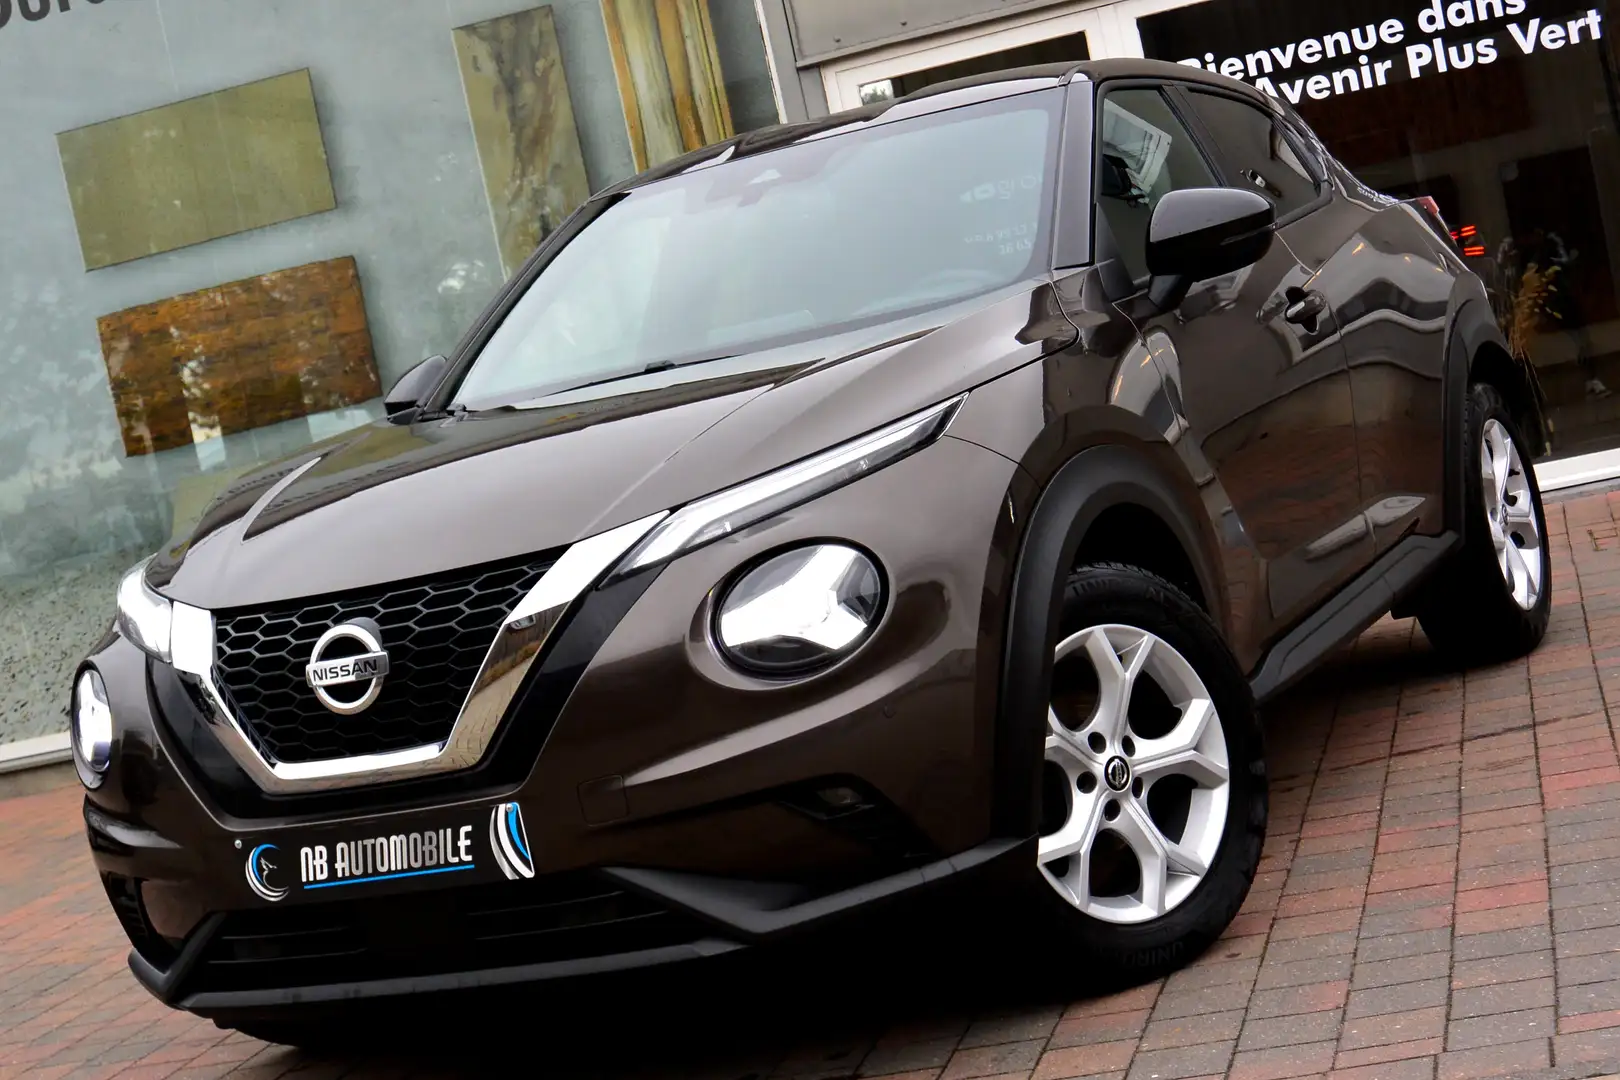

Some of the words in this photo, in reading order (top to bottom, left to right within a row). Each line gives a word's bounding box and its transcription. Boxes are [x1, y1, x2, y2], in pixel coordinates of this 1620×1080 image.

[1406, 37, 1498, 79] Plus
[1506, 9, 1602, 55] Vert
[312, 659, 378, 682] NISSAN
[300, 845, 329, 882] NB
[335, 825, 473, 878] AUTOMOBILE
